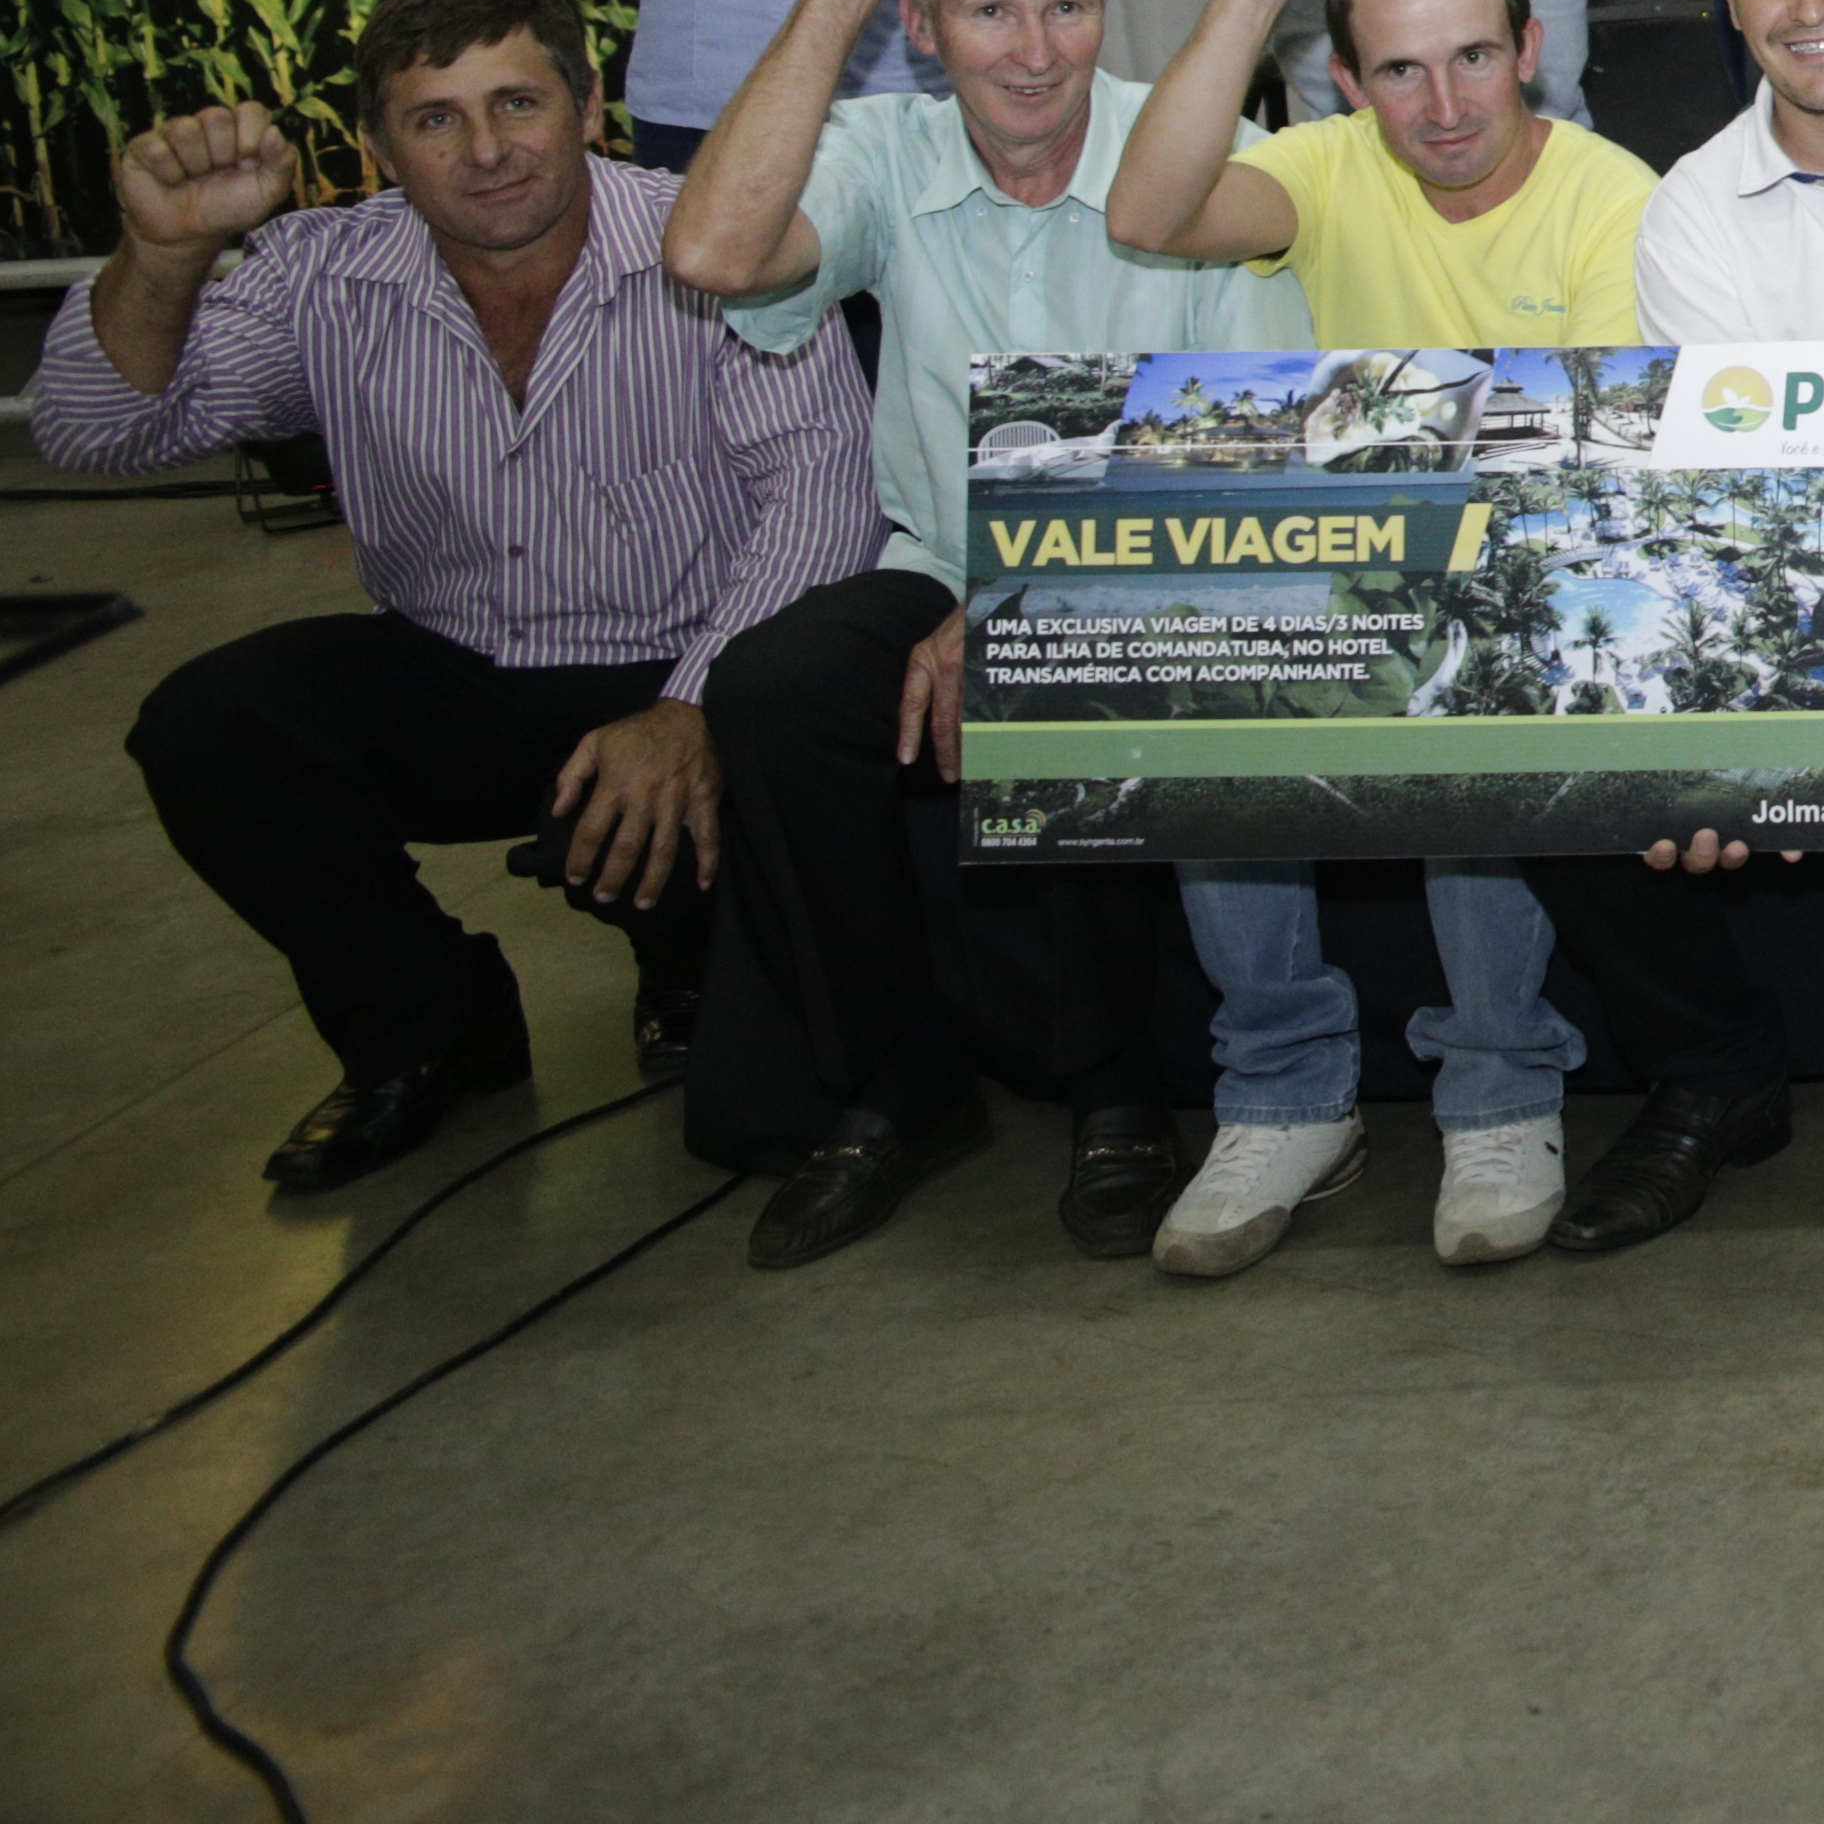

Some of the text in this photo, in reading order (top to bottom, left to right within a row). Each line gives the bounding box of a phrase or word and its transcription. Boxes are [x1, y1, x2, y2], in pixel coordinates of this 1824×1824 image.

[1781, 440, 1808, 455] Você
[990, 514, 1405, 568] VALE VIAGEM
[986, 613, 1425, 636] UMA EXCLUSIVA VIAGEM DE 4 DIAS/3 NOITES
[986, 637, 1393, 660] PARA ILHA DE COMANDATUBA, NO HOTEL
[986, 662, 1370, 685] TRANSAMÉRICA COM ACOMPANHANTE.
[981, 818, 1041, 834] c.a.s.a.
